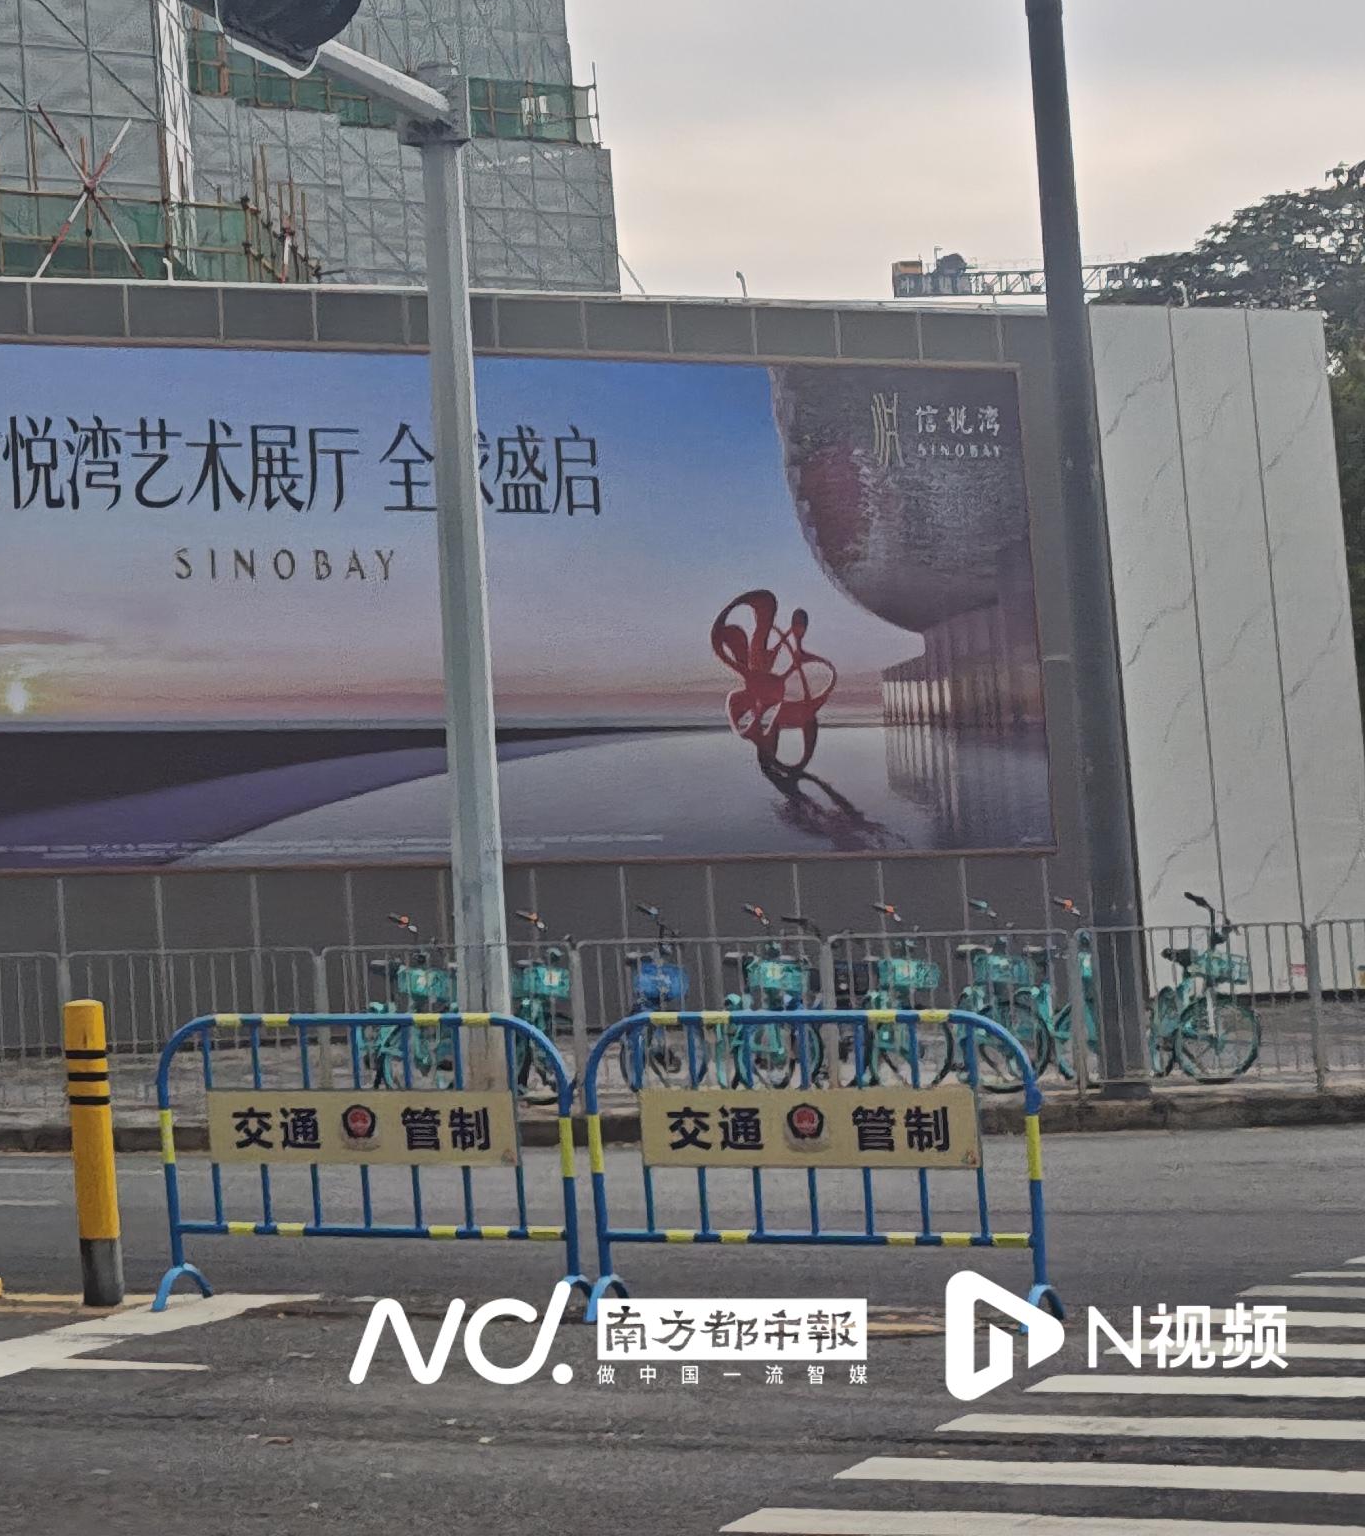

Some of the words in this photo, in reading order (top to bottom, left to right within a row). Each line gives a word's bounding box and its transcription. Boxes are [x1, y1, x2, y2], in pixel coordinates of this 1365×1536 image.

[378, 421, 602, 517] 全盛启
[173, 546, 397, 582] SINOBAY
[231, 1106, 322, 1151] 交通
[400, 1106, 492, 1151] 管制
[666, 1105, 765, 1152] 交通
[851, 1105, 951, 1152] 管制
